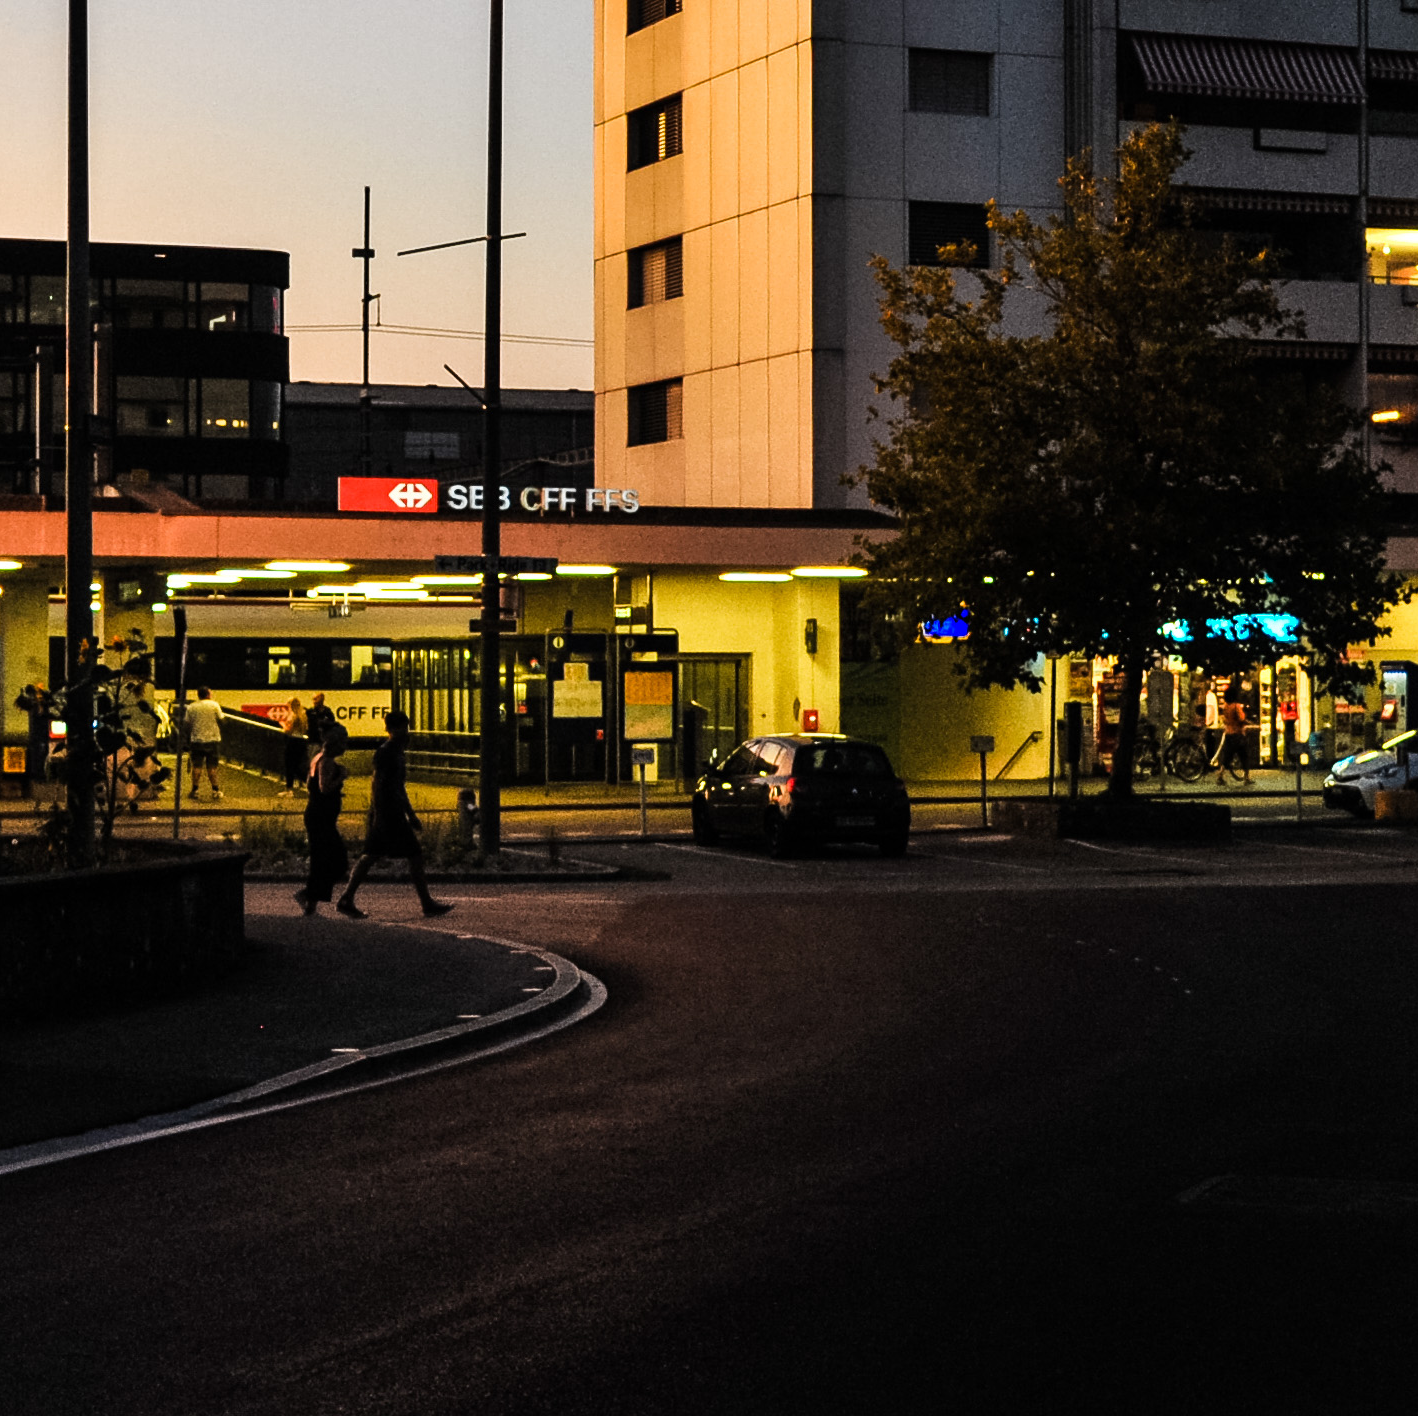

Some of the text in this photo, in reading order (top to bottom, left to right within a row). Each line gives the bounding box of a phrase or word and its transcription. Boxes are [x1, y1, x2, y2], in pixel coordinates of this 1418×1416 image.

[447, 484, 641, 514] SBB CFF FFS
[335, 706, 390, 720] CFF FF
